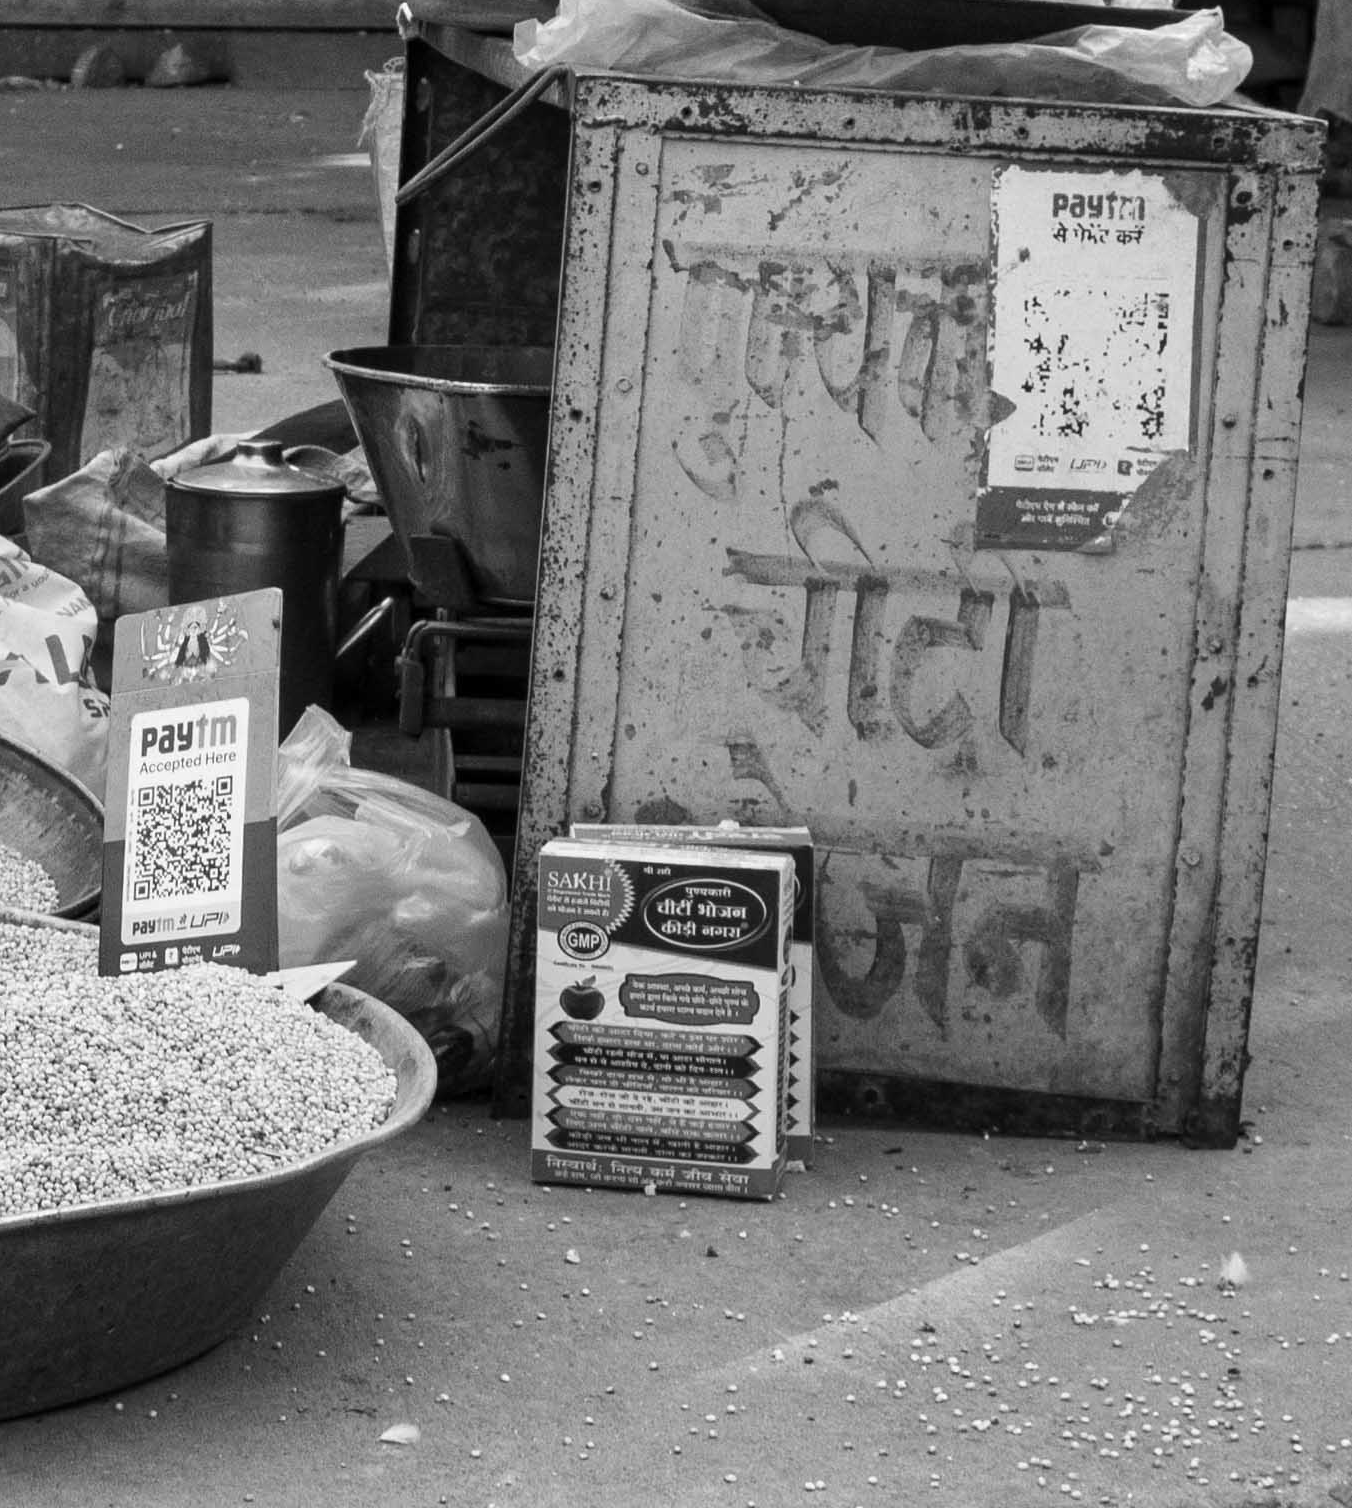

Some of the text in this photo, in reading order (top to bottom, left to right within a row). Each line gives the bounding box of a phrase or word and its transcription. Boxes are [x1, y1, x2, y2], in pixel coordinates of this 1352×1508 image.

[1116, 224, 1145, 245] करें
[139, 749, 237, 774] Accepted Here
[547, 870, 612, 892] SAKHI
[190, 911, 224, 929] UPI
[697, 899, 748, 921] भोजन
[567, 928, 601, 951] GMP
[701, 924, 741, 939] नगरा
[649, 1162, 675, 1179] कर्म
[718, 1168, 749, 1185] सेवा
